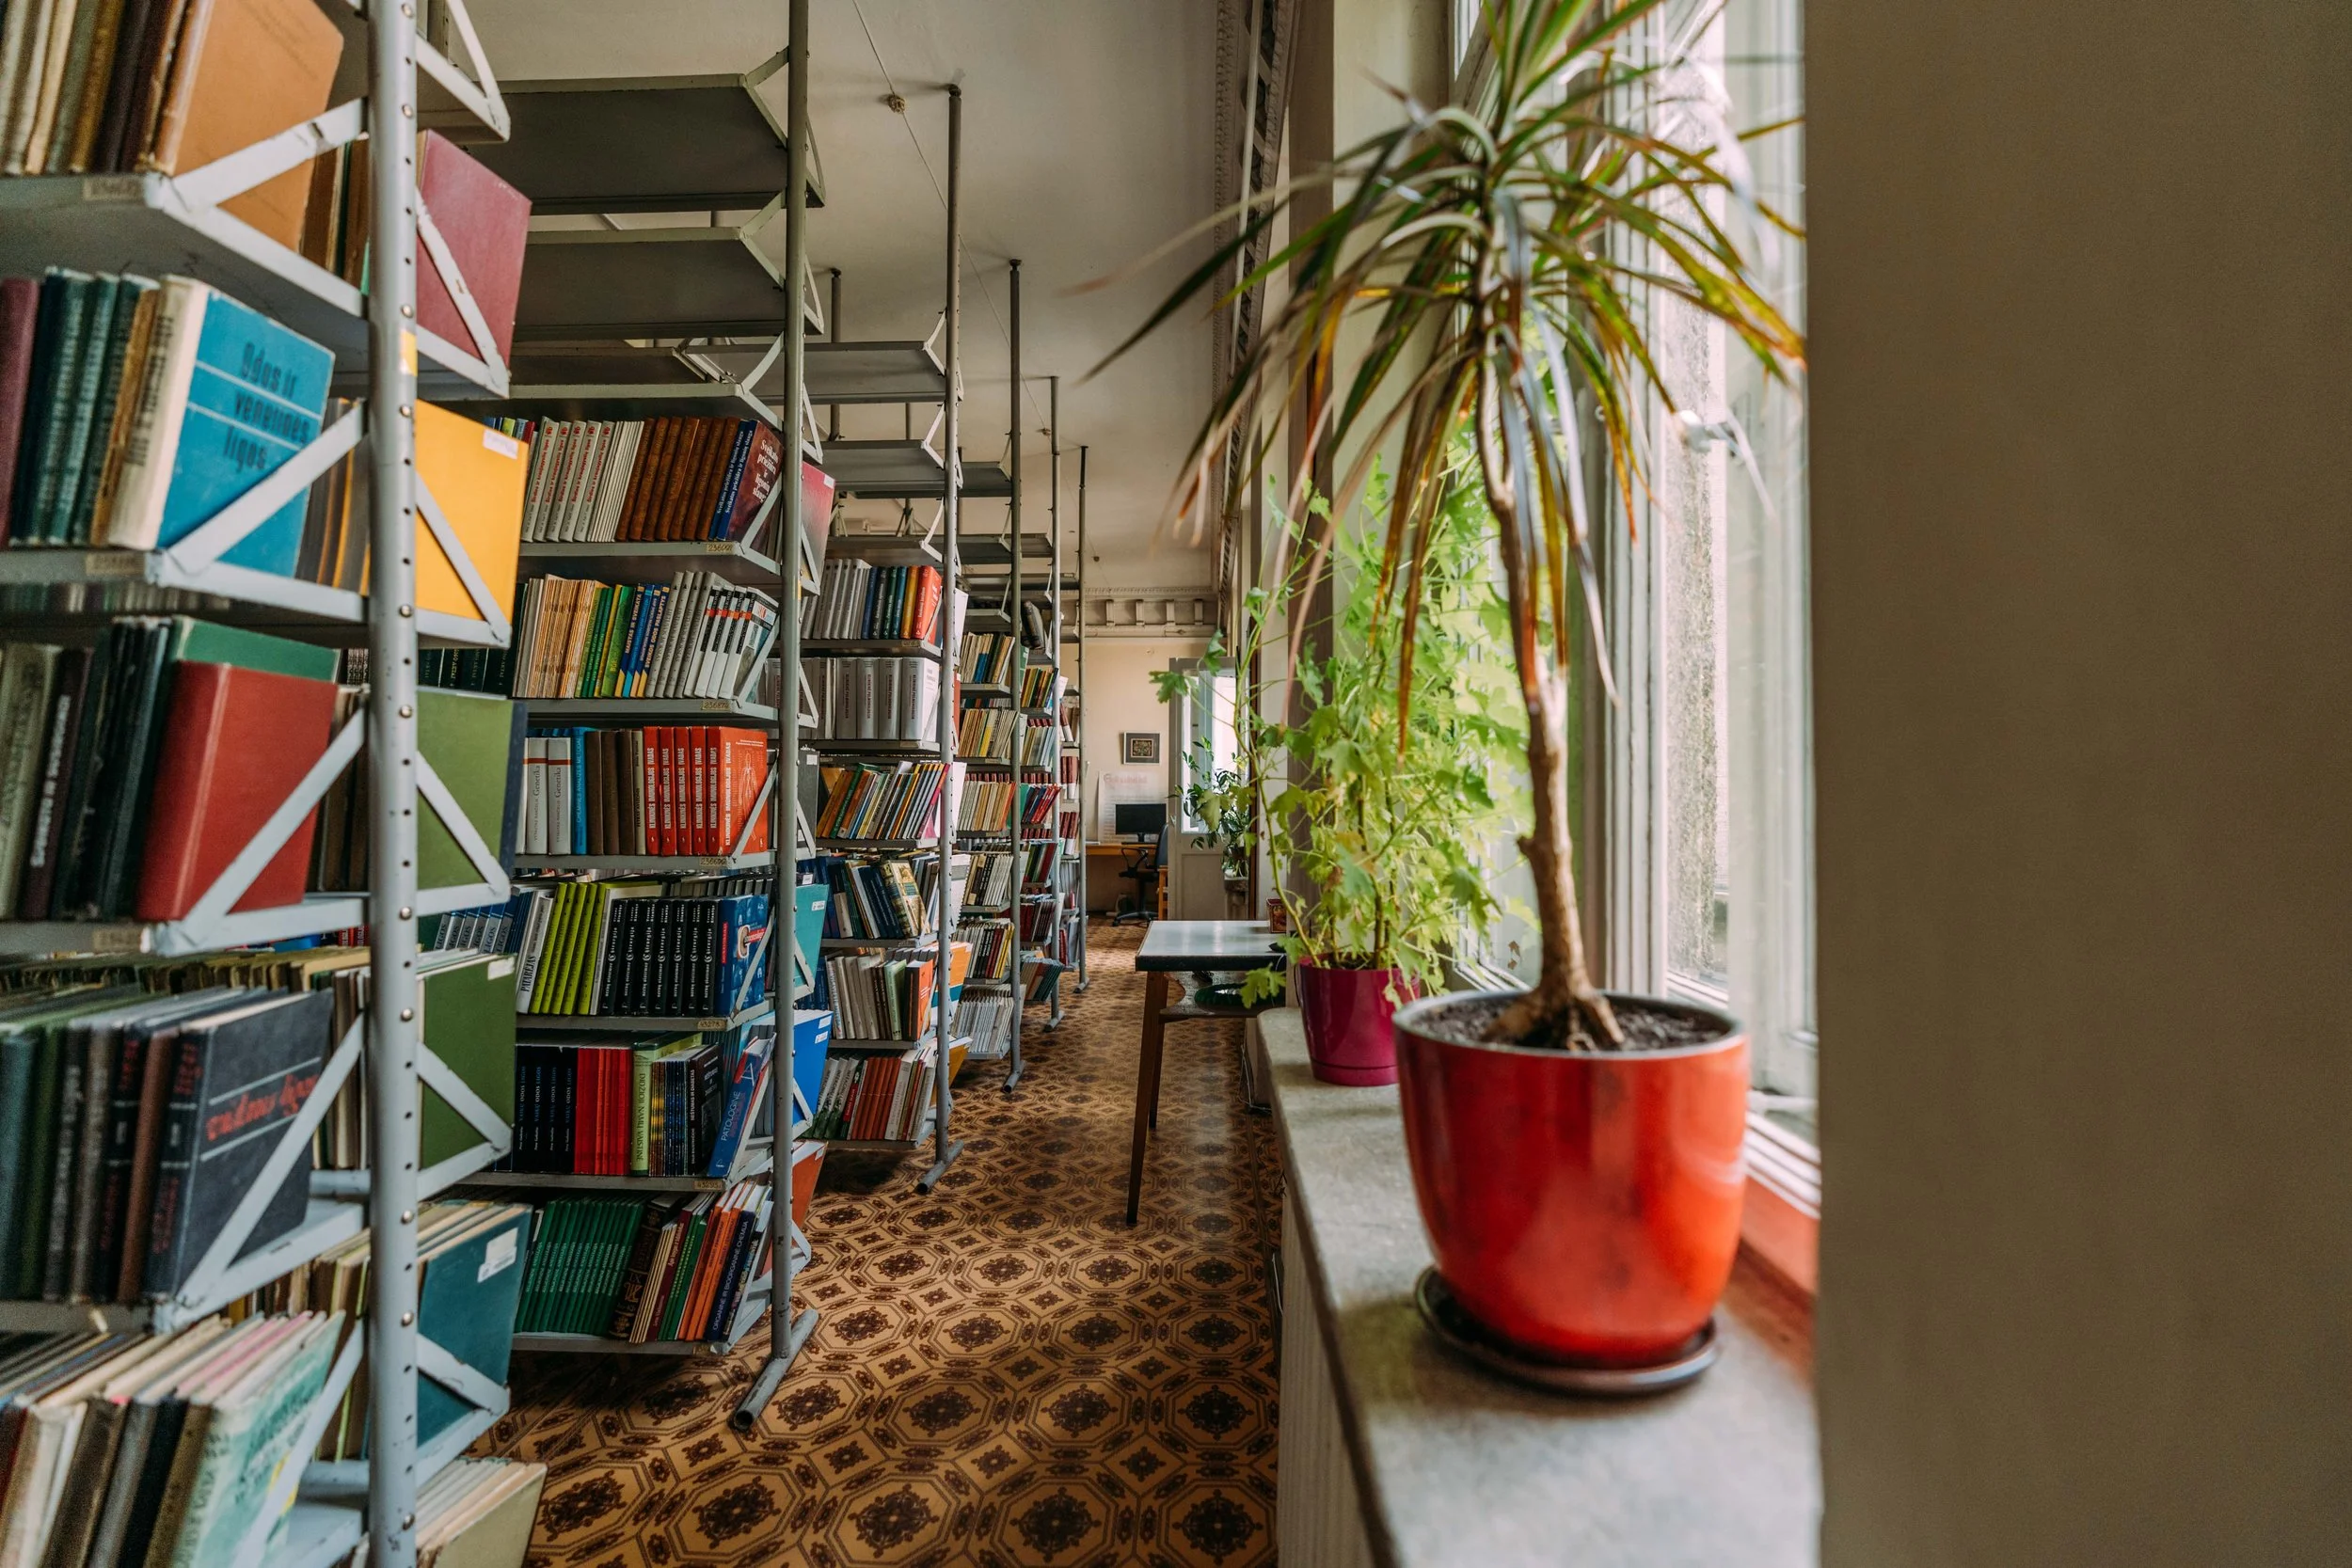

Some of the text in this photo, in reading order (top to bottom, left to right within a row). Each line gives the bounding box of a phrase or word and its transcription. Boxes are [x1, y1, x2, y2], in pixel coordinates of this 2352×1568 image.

[240, 341, 297, 400] Odos ir
[224, 425, 267, 474] ligos
[625, 629, 634, 654] MAISTAS
[631, 594, 642, 621] SVEIKATA
[644, 595, 666, 668] SVEIKOS ODOS PASLAPTYS
[447, 925, 460, 949] IGOS
[460, 925, 471, 946] IGOS
[472, 925, 484, 946] IGOS
[484, 926, 497, 953] LIGOS
[495, 926, 508, 952] LIGOS
[519, 955, 536, 992] PATARĖJAS
[721, 1091, 741, 1142] PATOLOGINĖ
[711, 1297, 727, 1332] ORGANINĖ
[736, 1220, 749, 1247] CHEMIJA
